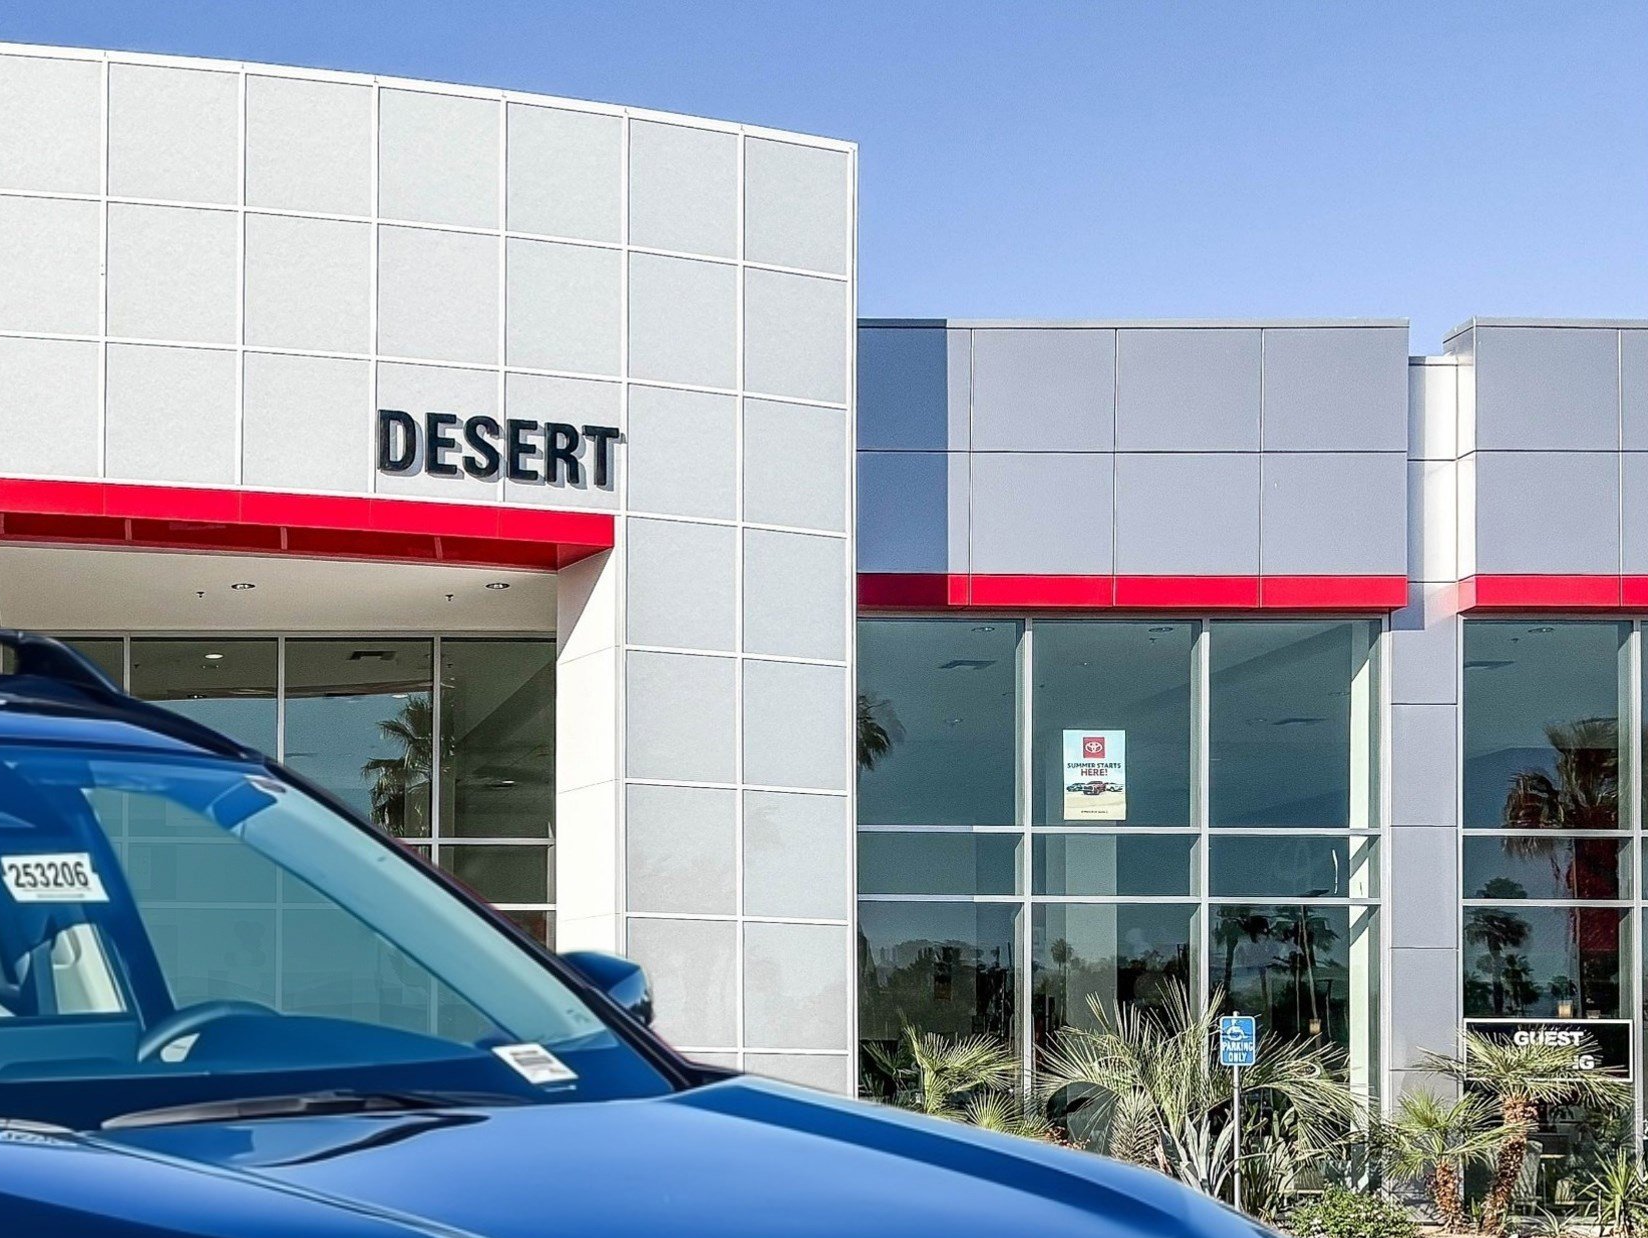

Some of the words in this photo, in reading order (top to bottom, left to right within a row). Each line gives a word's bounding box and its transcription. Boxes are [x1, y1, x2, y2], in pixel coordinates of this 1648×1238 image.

[377, 408, 620, 488] DESERT
[8, 861, 89, 888] 253206
[1222, 1041, 1253, 1052] PARKING
[1513, 1031, 1584, 1047] GUEST
[1228, 1051, 1247, 1063] ONLY
